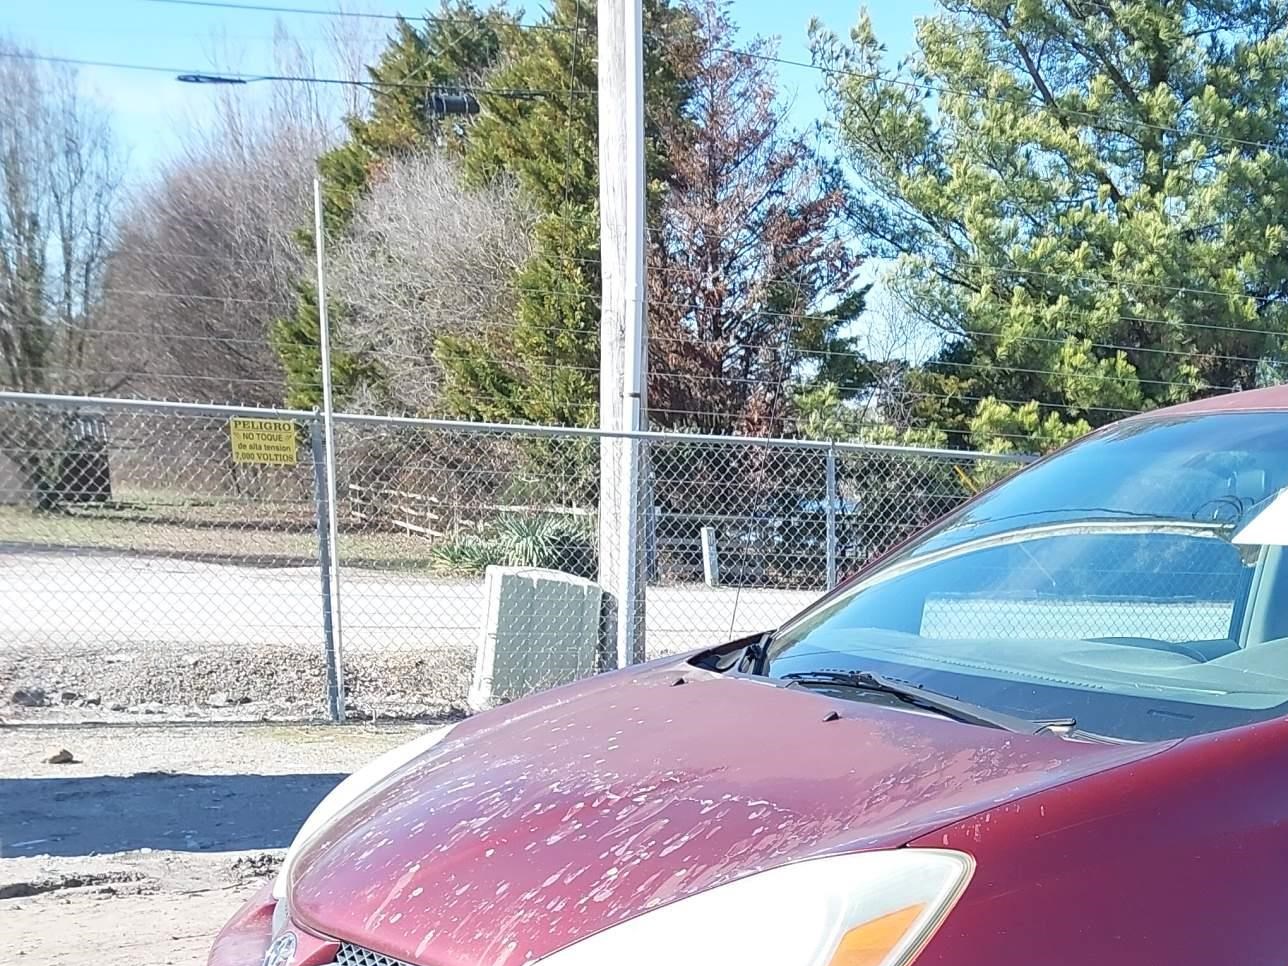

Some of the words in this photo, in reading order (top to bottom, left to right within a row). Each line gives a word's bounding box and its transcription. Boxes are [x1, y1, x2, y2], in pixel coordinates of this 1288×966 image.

[234, 420, 291, 431] PELIGRO
[242, 432, 254, 440] NO
[256, 433, 283, 441] TOQUE
[238, 442, 247, 450] de
[264, 444, 291, 452] tension
[256, 453, 294, 462] VOLTIOS
